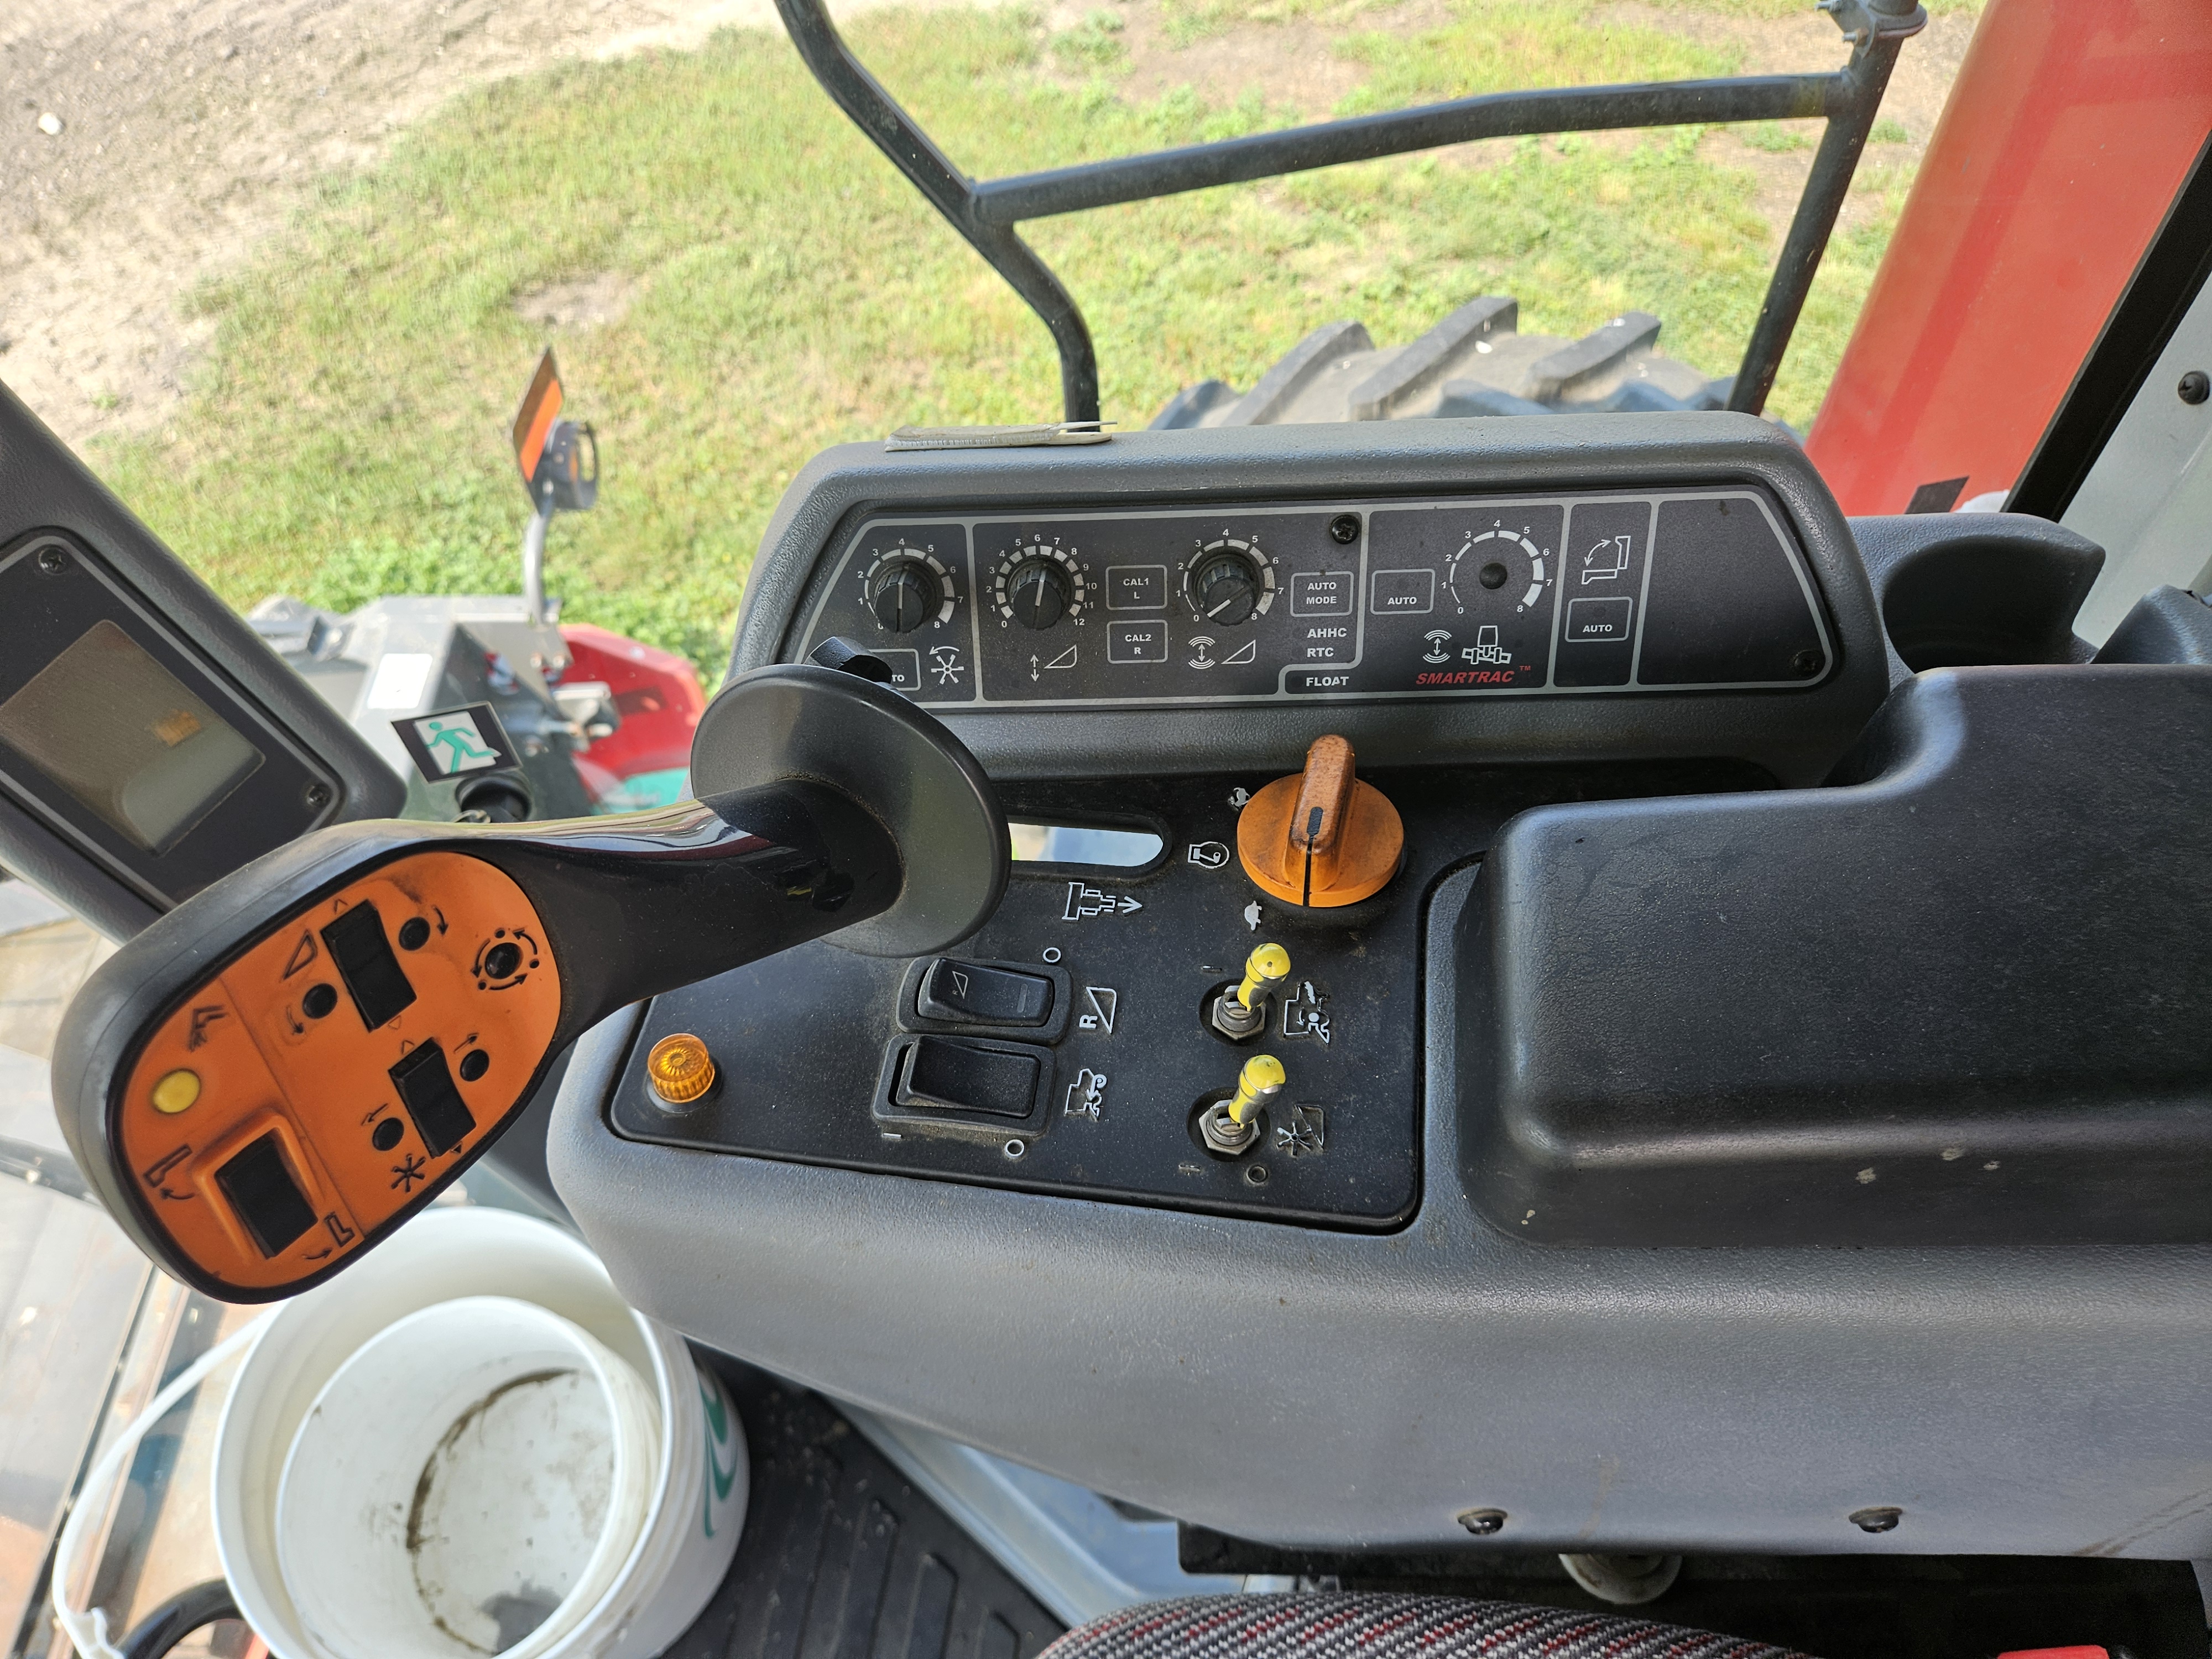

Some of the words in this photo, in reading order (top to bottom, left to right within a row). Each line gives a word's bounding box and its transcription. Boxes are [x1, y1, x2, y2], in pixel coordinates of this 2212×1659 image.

[1493, 519, 1501, 528] 4
[1222, 528, 1229, 536] 4
[1523, 526, 1530, 534] 5
[872, 548, 879, 556] 3
[928, 544, 934, 552] 5
[1543, 548, 1550, 556] 6
[1445, 554, 1452, 562] 2
[1123, 577, 1149, 586] CAL1
[1546, 578, 1553, 587] 7
[1307, 582, 1337, 591] AUTO
[1306, 596, 1337, 604] MODE
[1387, 596, 1417, 605] AUTO
[1516, 604, 1524, 613] 8
[1307, 627, 1347, 638] AHHC
[1582, 624, 1613, 633] AUTO
[1125, 634, 1151, 642] CAL2
[1307, 647, 1334, 658] RTC
[1306, 676, 1349, 687] FLOAT
[1416, 670, 1515, 685] SMARTRAC
[1079, 1014, 1098, 1029] R
